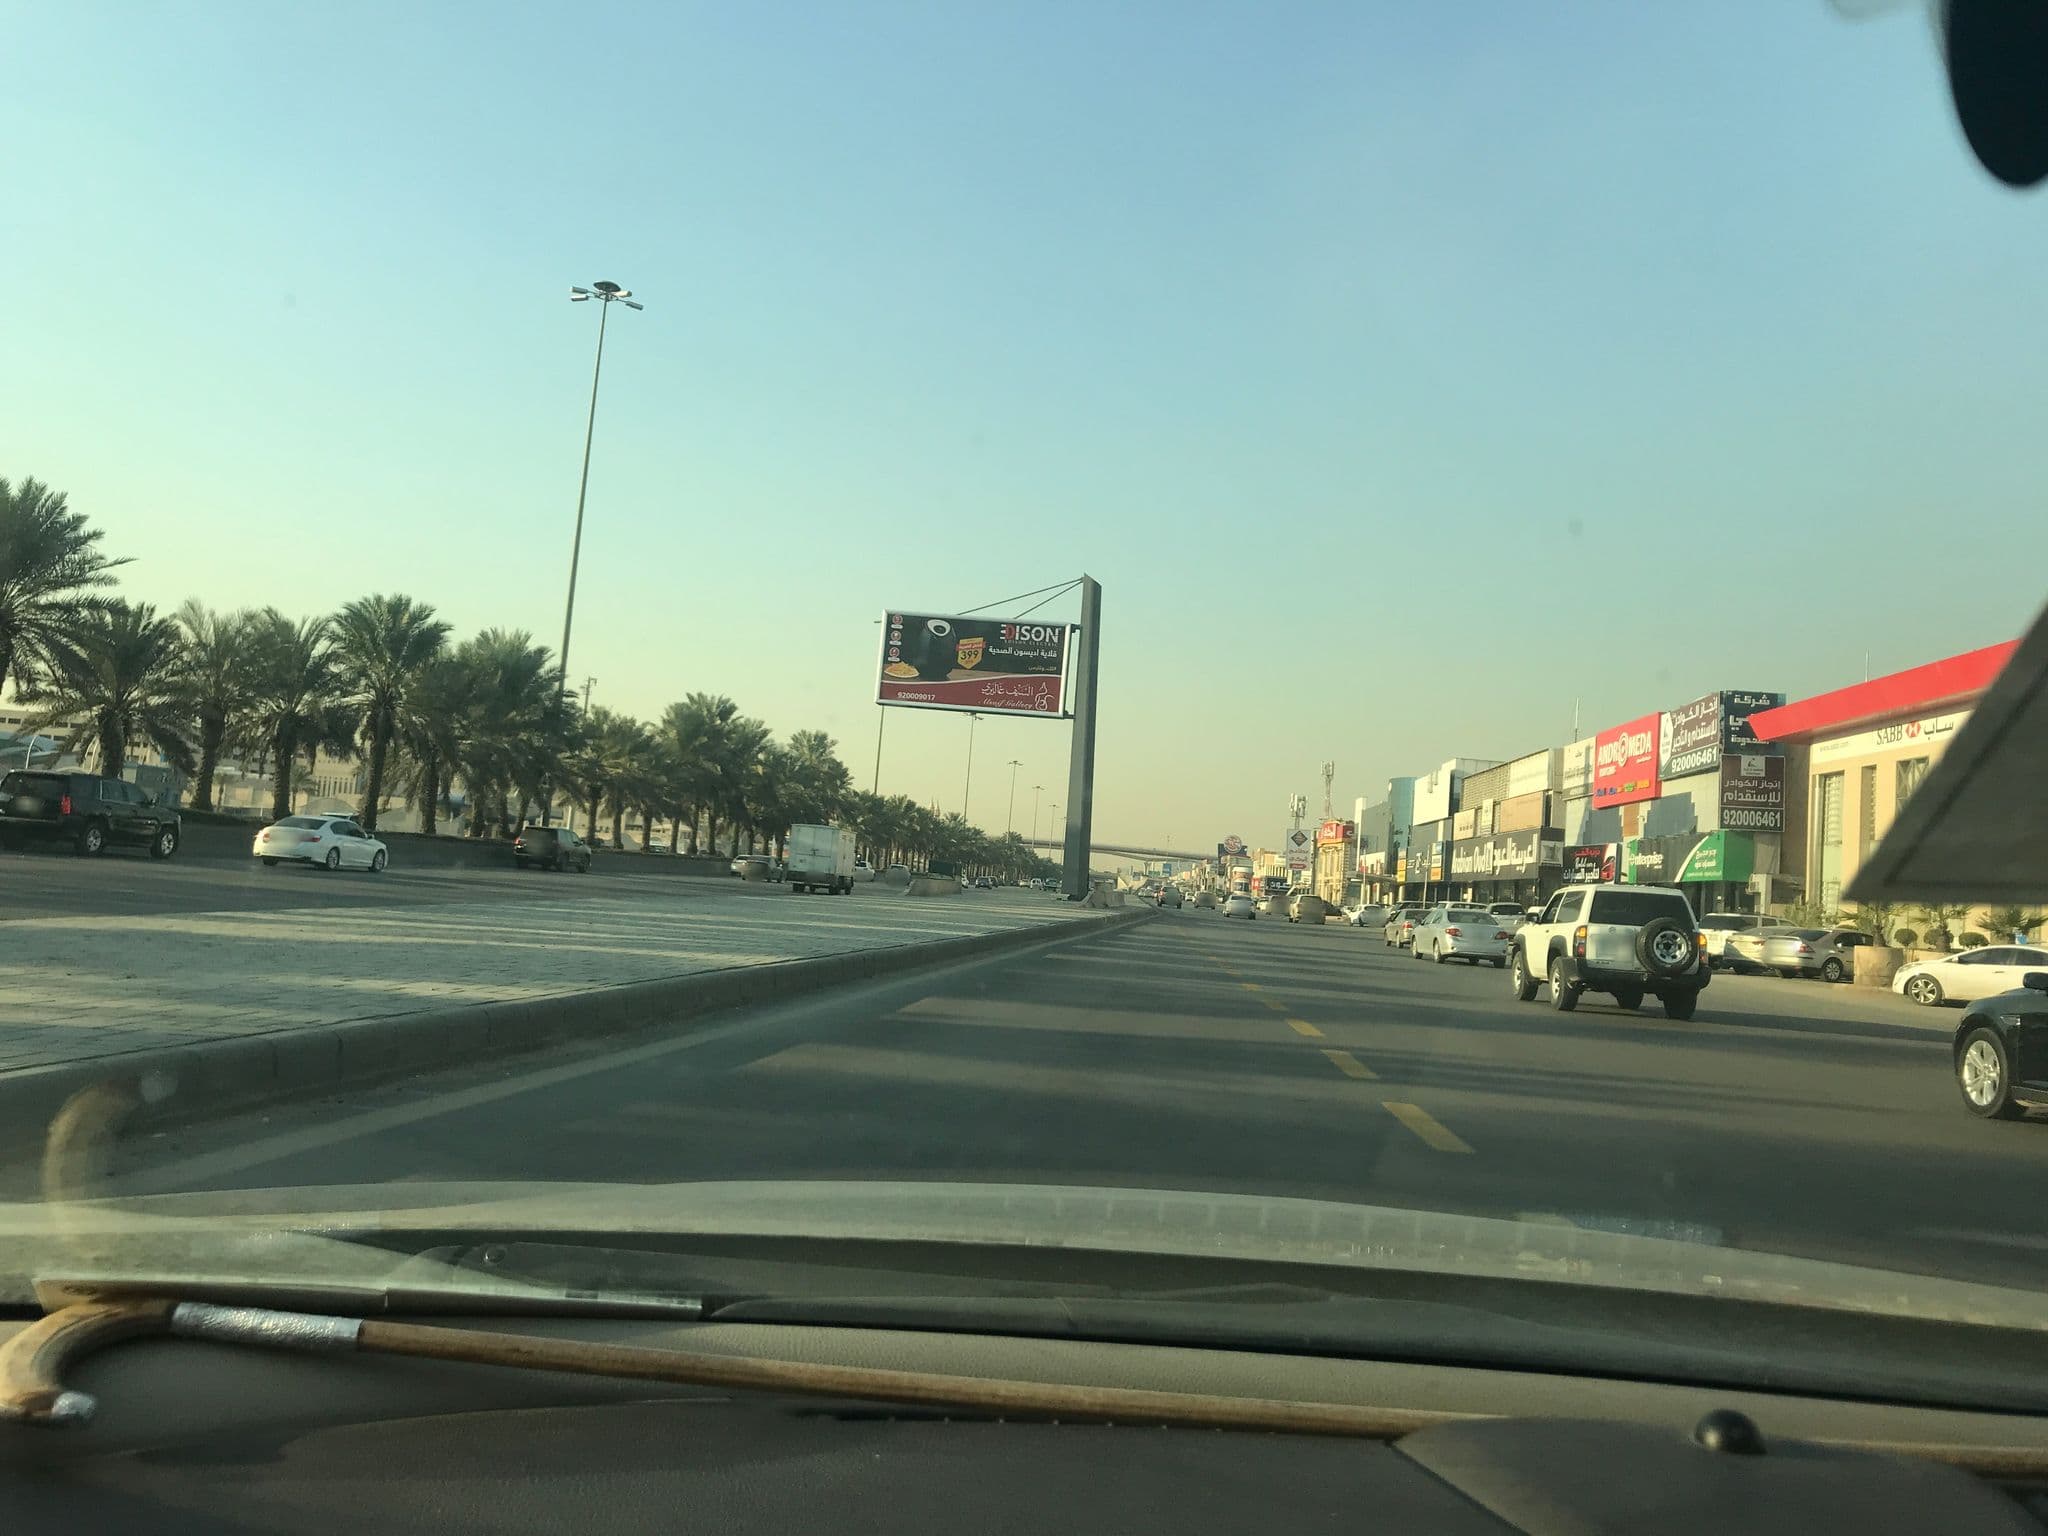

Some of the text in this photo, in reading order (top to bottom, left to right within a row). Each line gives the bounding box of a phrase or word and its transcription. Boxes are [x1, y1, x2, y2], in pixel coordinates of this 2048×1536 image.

[1000, 623, 1059, 643] EDISON
[960, 650, 979, 660] 399
[988, 645, 1013, 656] الصحية
[897, 692, 935, 701] 920009017
[1734, 694, 1770, 708] شركة
[1876, 724, 1903, 745] SABB
[1923, 717, 1953, 741] ساب
[1597, 731, 1652, 768] ANDROMEDA
[1671, 746, 1718, 773] 920006461
[1723, 809, 1780, 827] 920006461
